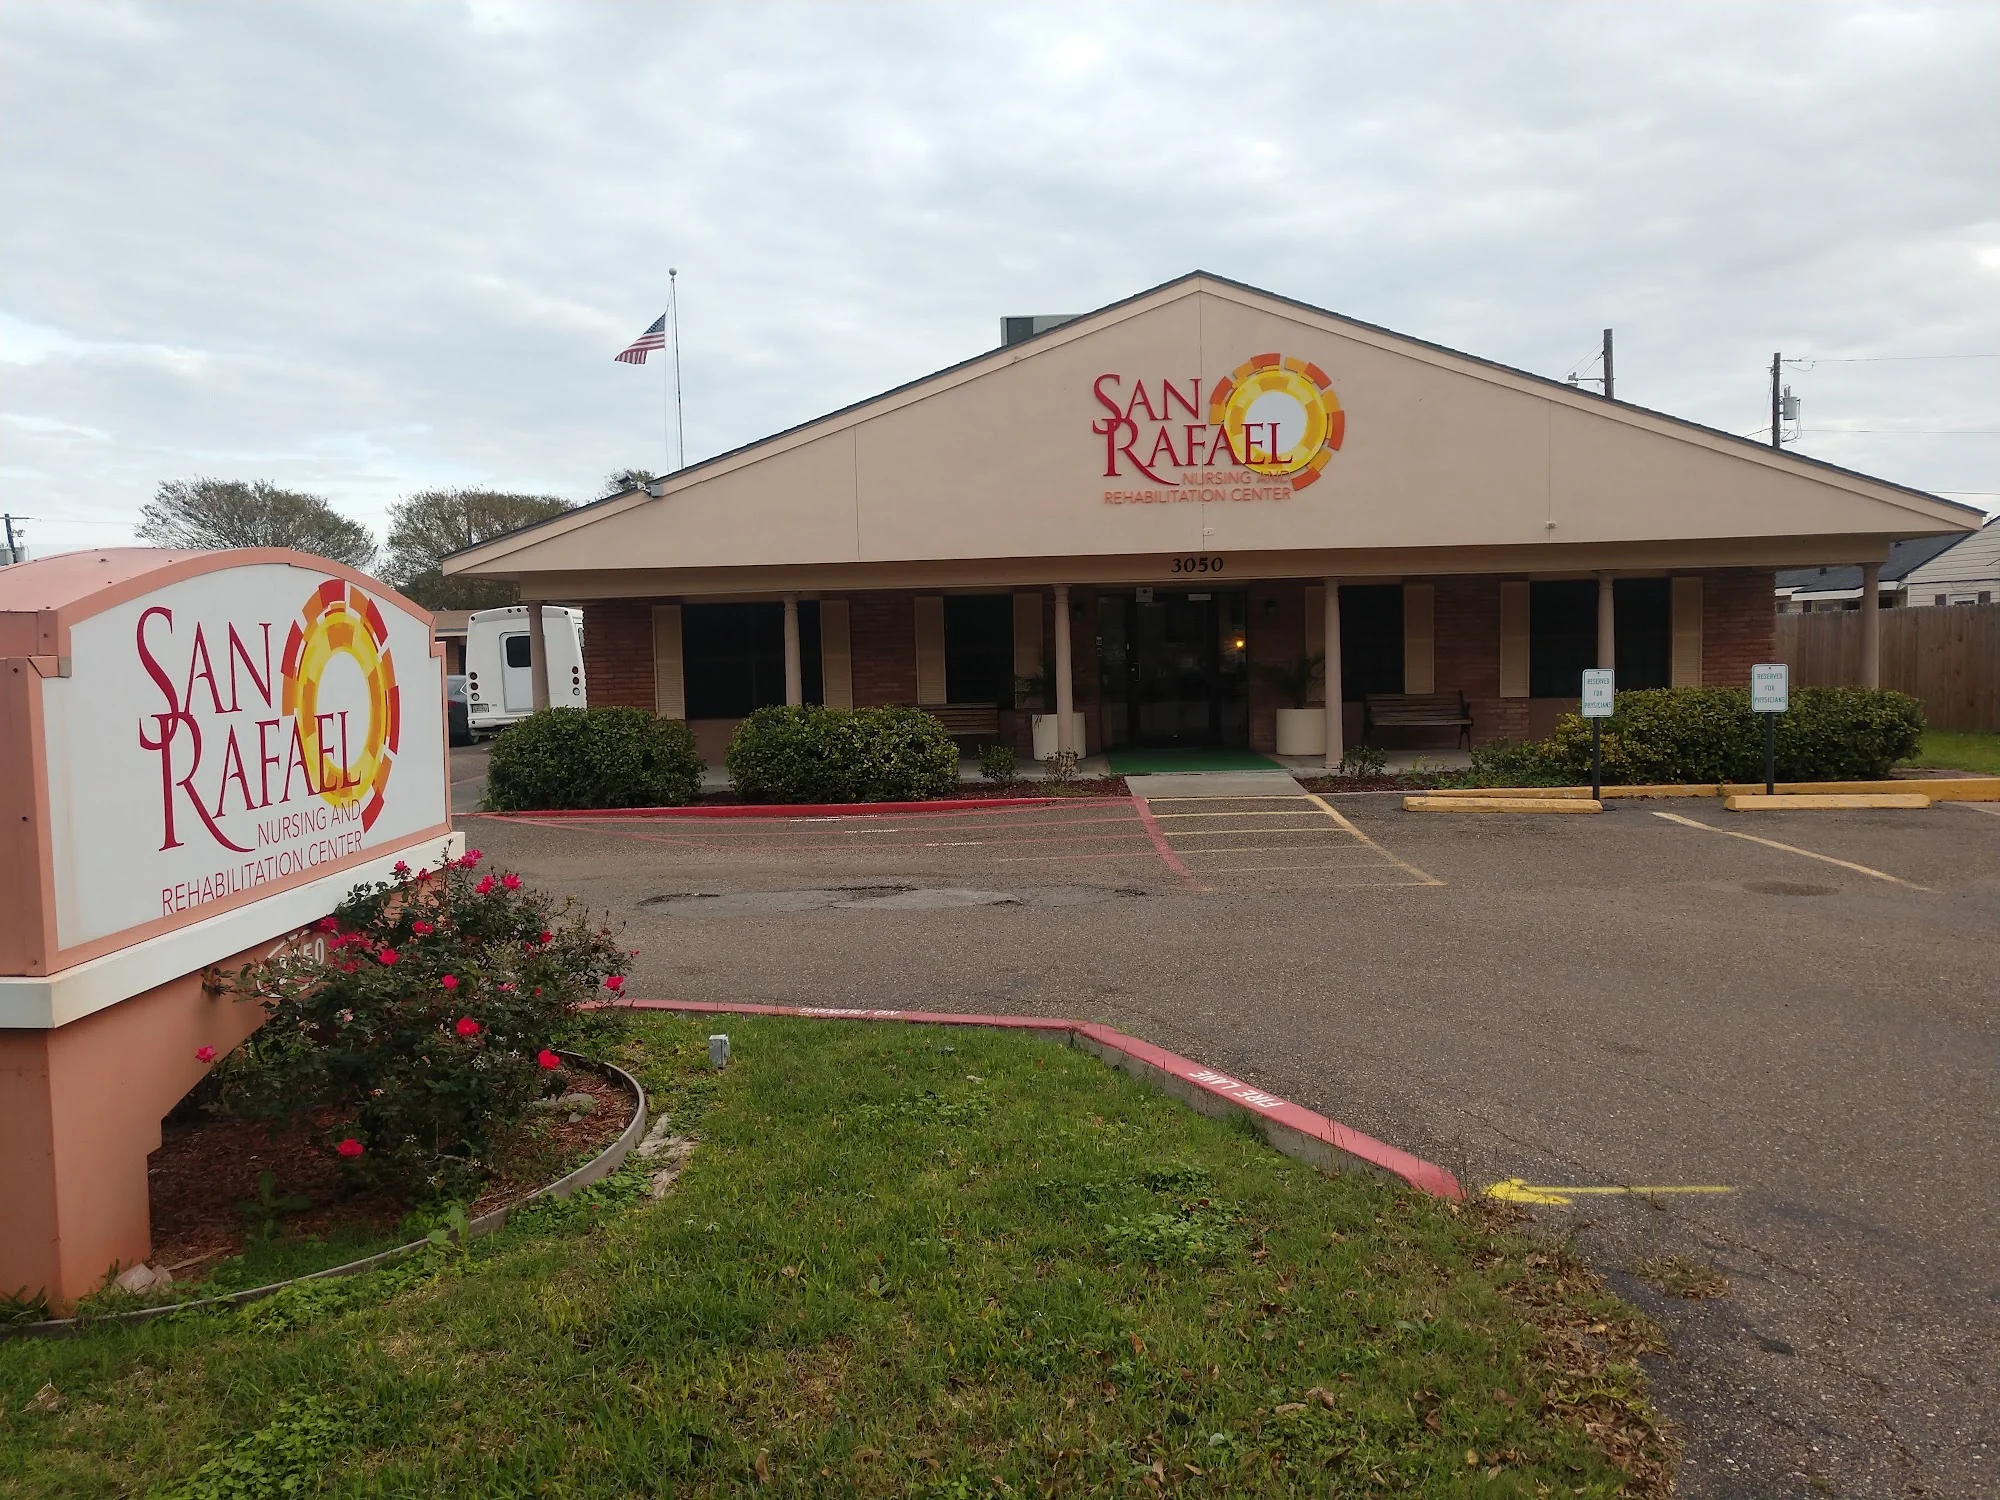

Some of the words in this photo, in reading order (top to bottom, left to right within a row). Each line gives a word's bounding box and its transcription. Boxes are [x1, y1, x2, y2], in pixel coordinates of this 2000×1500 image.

[1092, 373, 1201, 434] SAN
[1101, 418, 1293, 486] RAFAEL
[1182, 471, 1251, 485] NURSING
[1256, 470, 1291, 484] AND
[1104, 489, 1226, 505] REHABILITATION
[1231, 487, 1291, 502] CENTER
[1170, 557, 1224, 573] 3050
[136, 606, 272, 750] SAN
[1757, 672, 1783, 680] RESERVED
[1764, 684, 1775, 692] FOR
[1754, 696, 1786, 704] PHYSICIANS
[150, 710, 362, 853] RAFAEL
[257, 816, 327, 848] NURSING
[330, 798, 362, 826] AND
[161, 848, 303, 916] REHABILITATION
[308, 831, 362, 866] CENTER
[1188, 1070, 1240, 1090] LANE
[1233, 1089, 1284, 1108] FIRE
